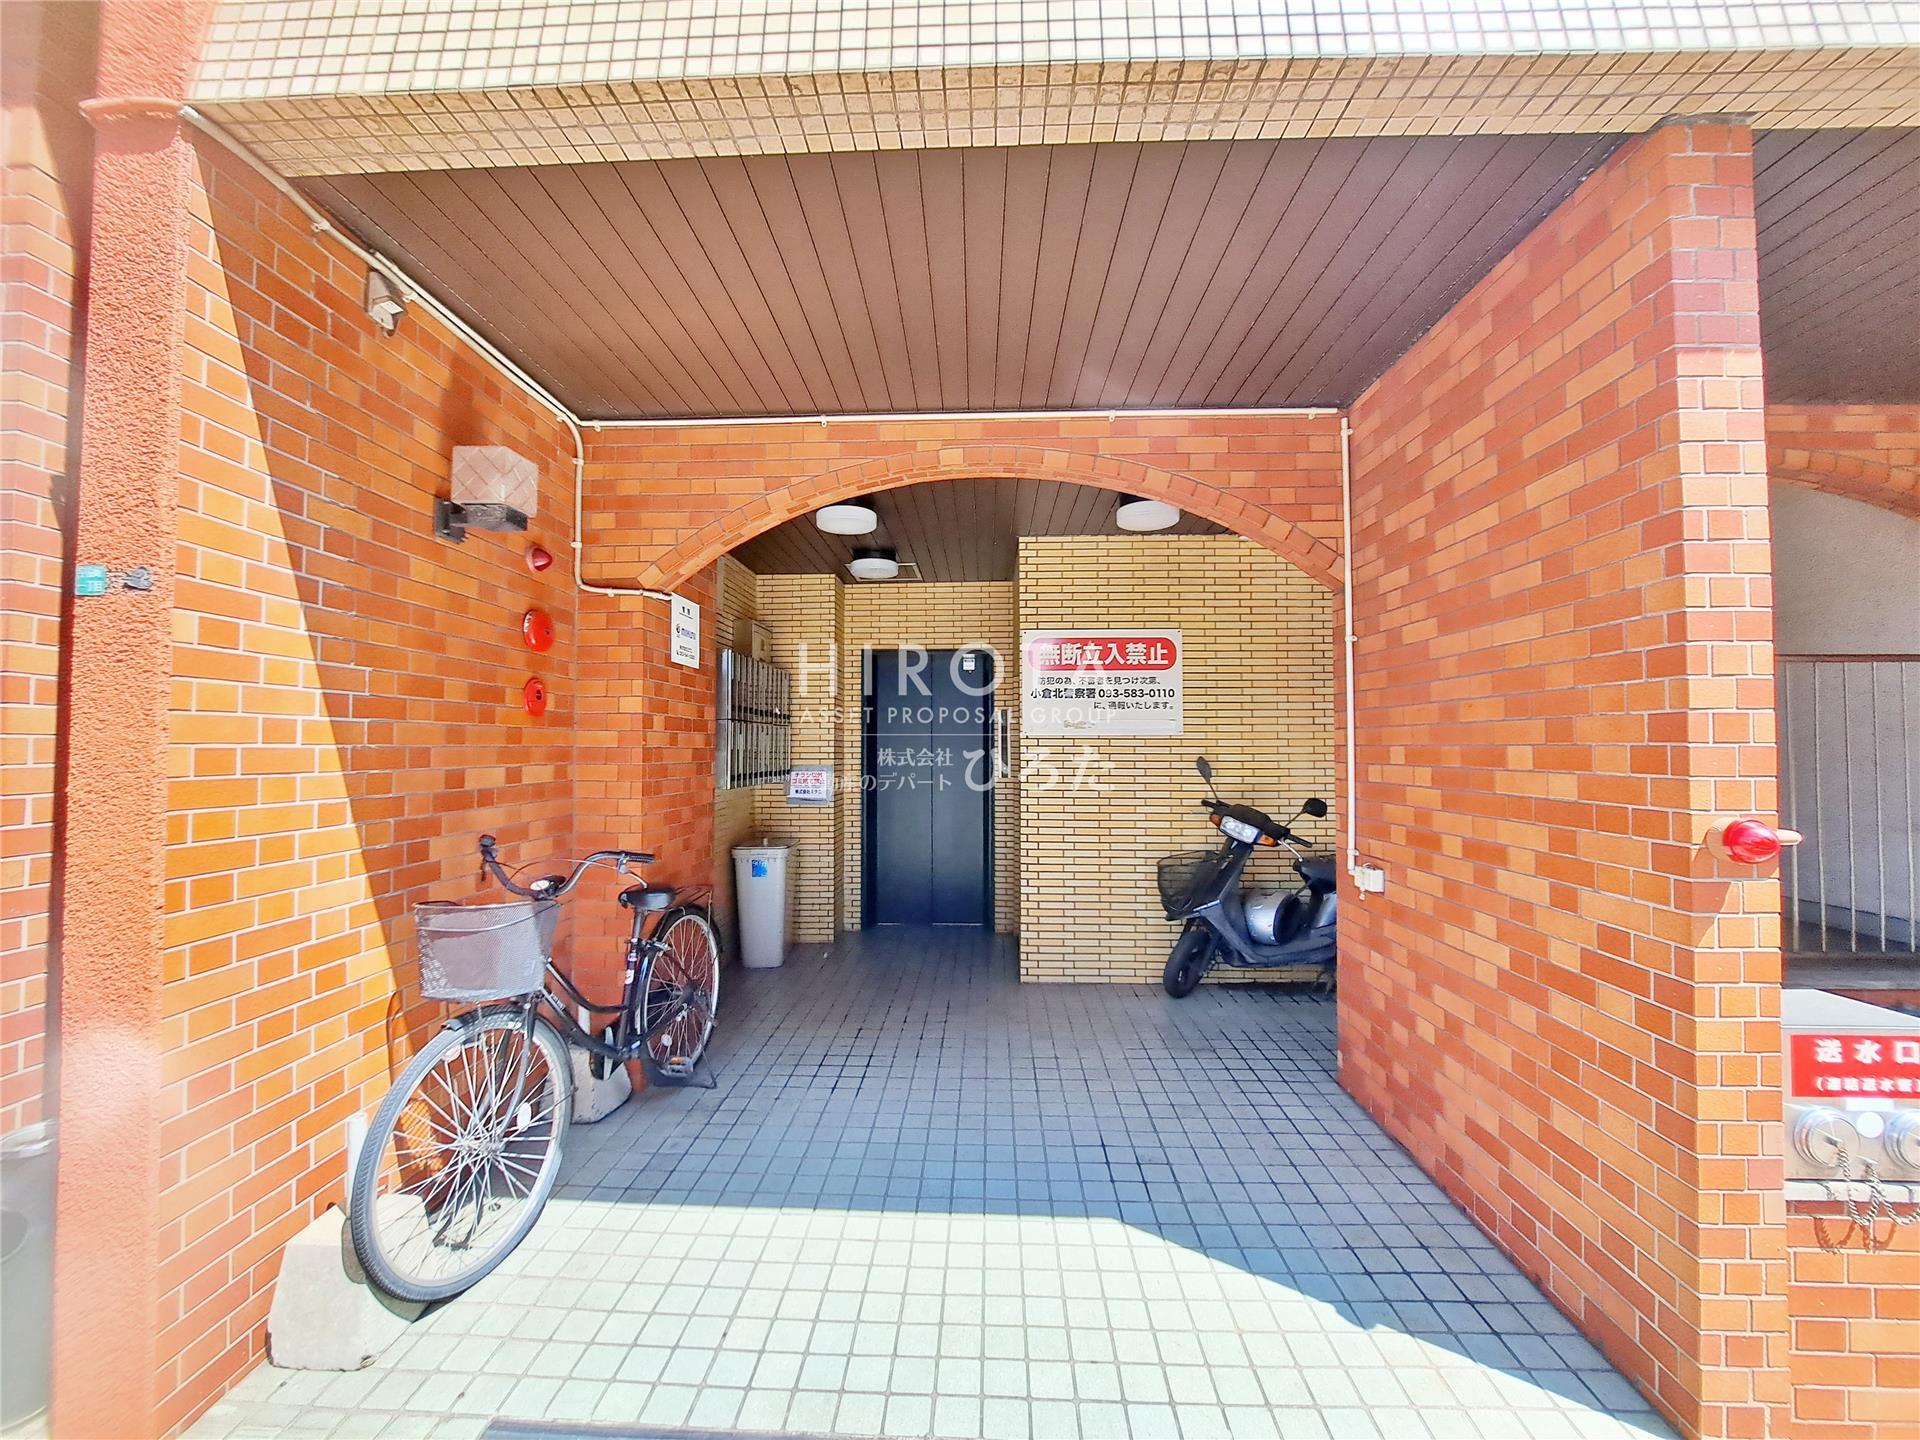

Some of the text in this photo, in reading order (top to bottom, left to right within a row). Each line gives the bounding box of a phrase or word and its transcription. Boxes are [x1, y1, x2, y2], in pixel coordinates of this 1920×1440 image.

[1039, 641, 1169, 666] 無断立入禁止
[1099, 688, 1175, 698] 093-583-0110
[1814, 1038, 1920, 1064] 送水口
